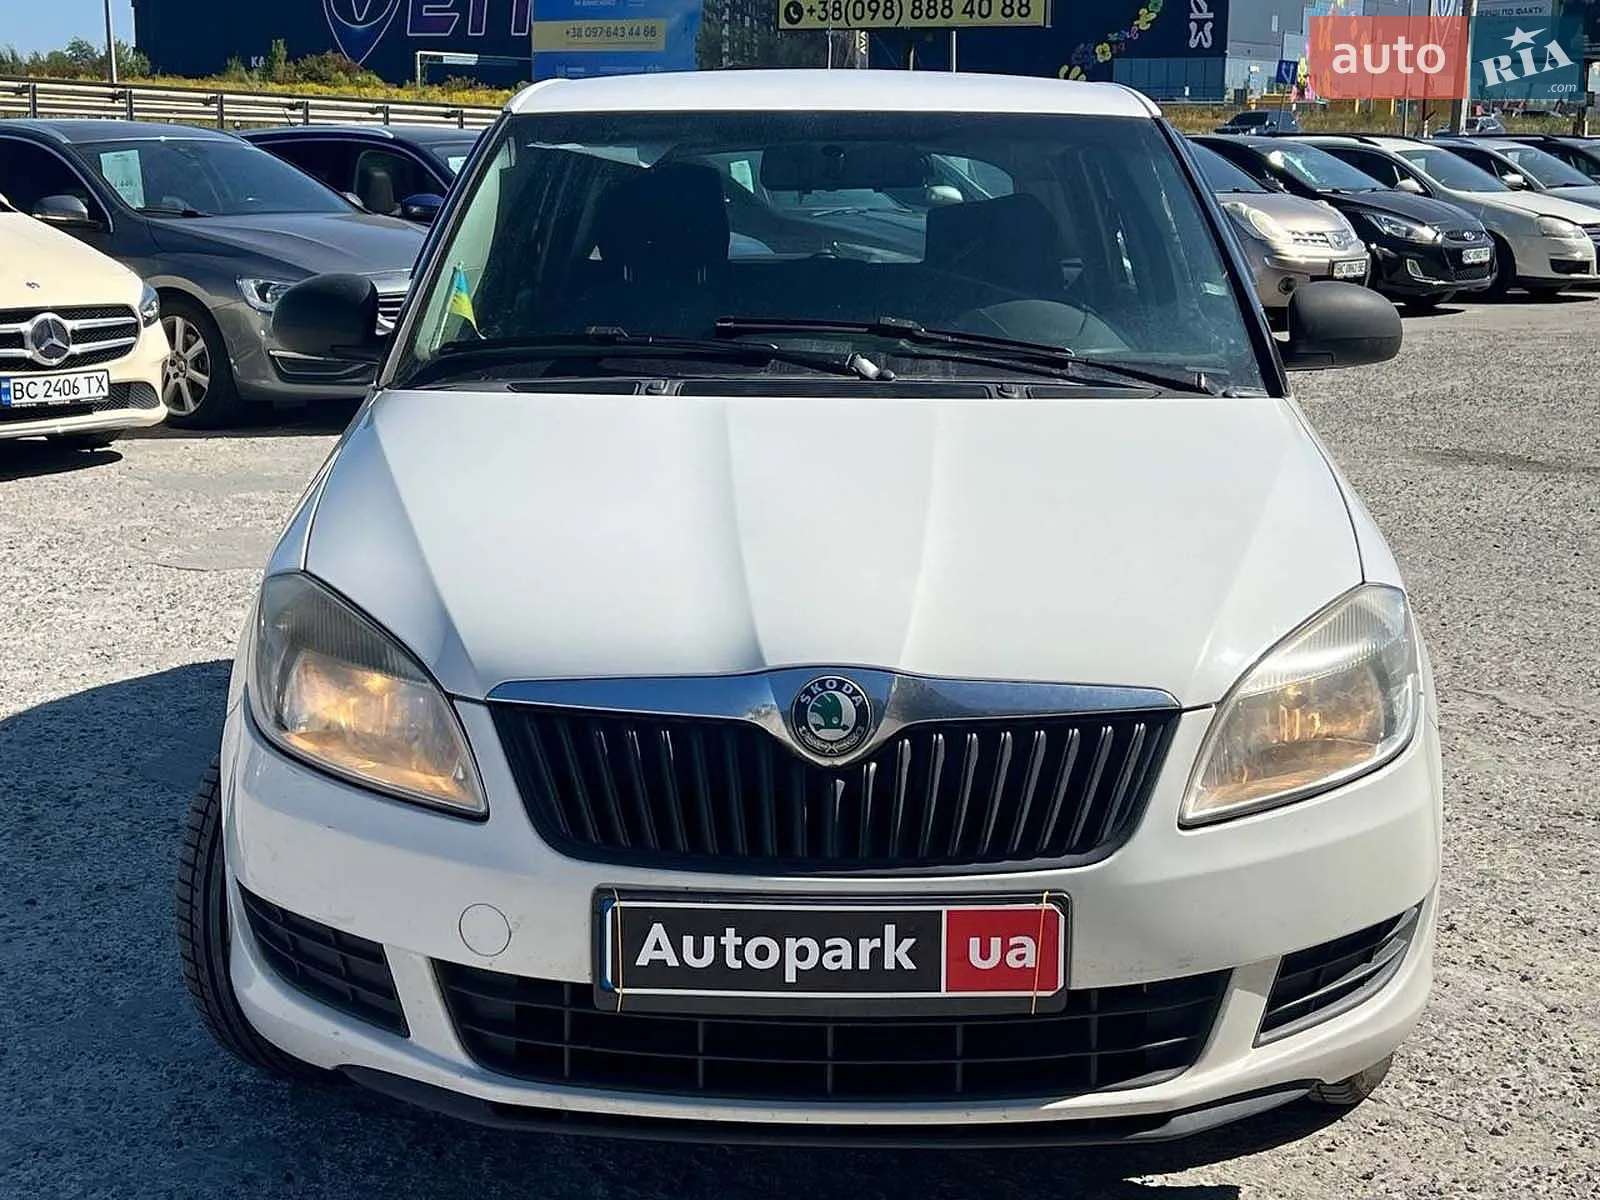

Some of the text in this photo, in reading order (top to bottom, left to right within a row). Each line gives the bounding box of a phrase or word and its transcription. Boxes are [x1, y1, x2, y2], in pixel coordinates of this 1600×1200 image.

[910, 0, 953, 19] 888
[961, 0, 991, 18] 40
[1001, 0, 1031, 18] 88
[13, 374, 105, 400] BC 2406 TX
[800, 680, 863, 707] SKODA
[635, 922, 1037, 983] Autopark ua
